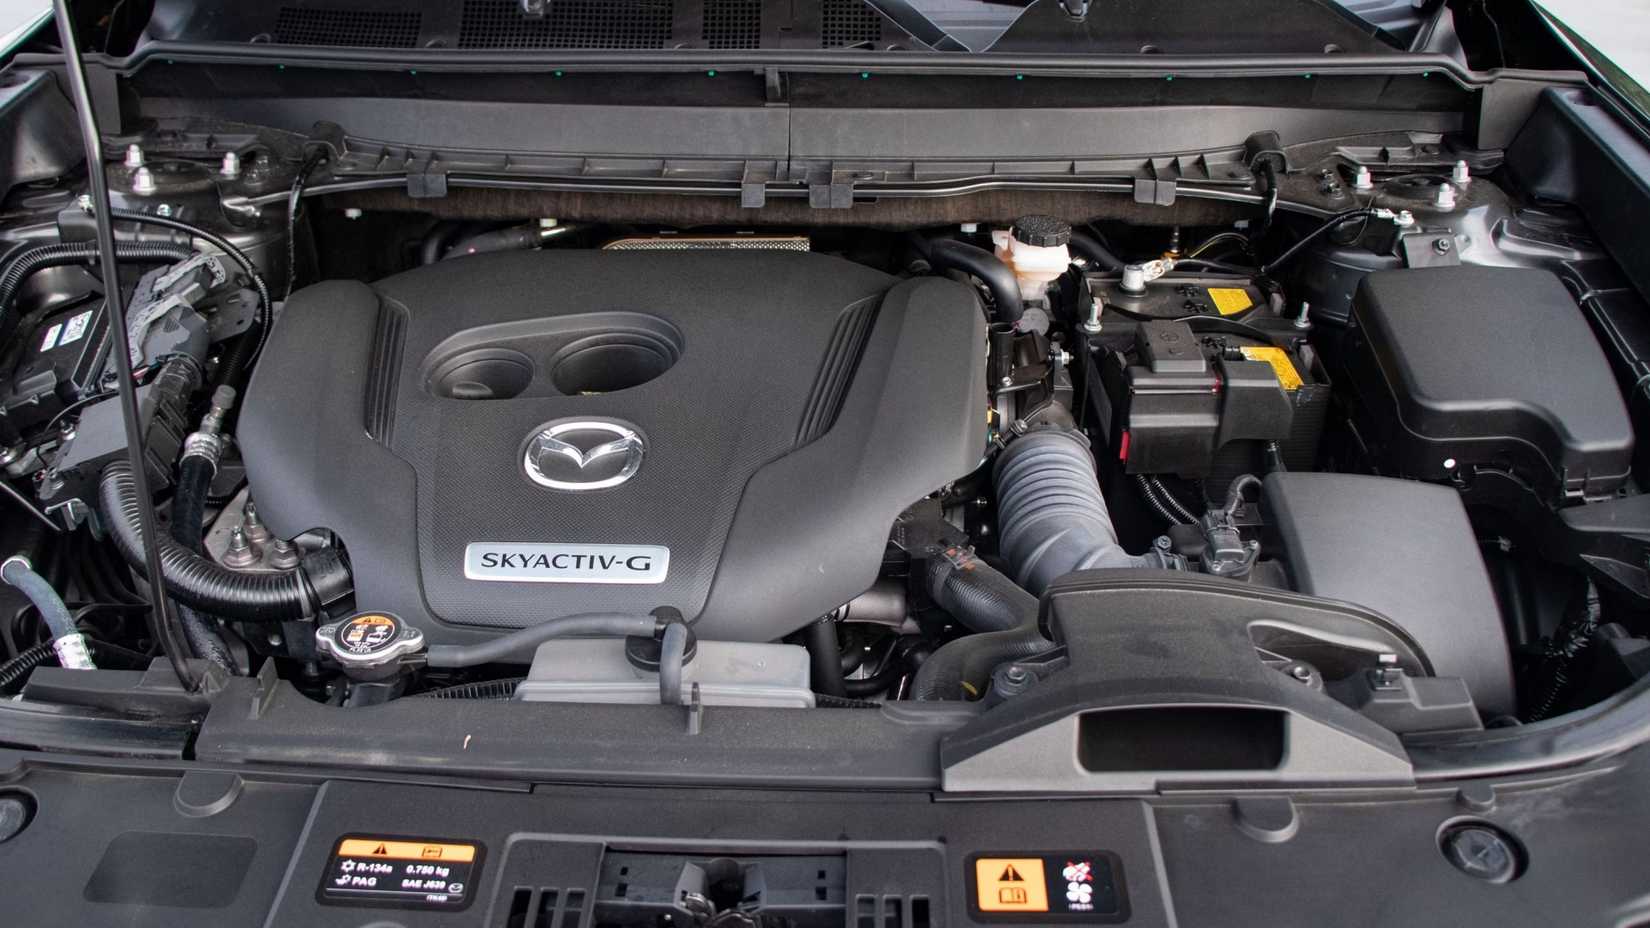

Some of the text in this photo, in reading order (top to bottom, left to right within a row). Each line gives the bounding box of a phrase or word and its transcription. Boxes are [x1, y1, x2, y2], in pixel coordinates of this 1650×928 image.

[480, 552, 652, 571] SKYACTIV-G
[356, 862, 450, 877] R-134a 0.750 kg
[352, 876, 377, 887] PAG
